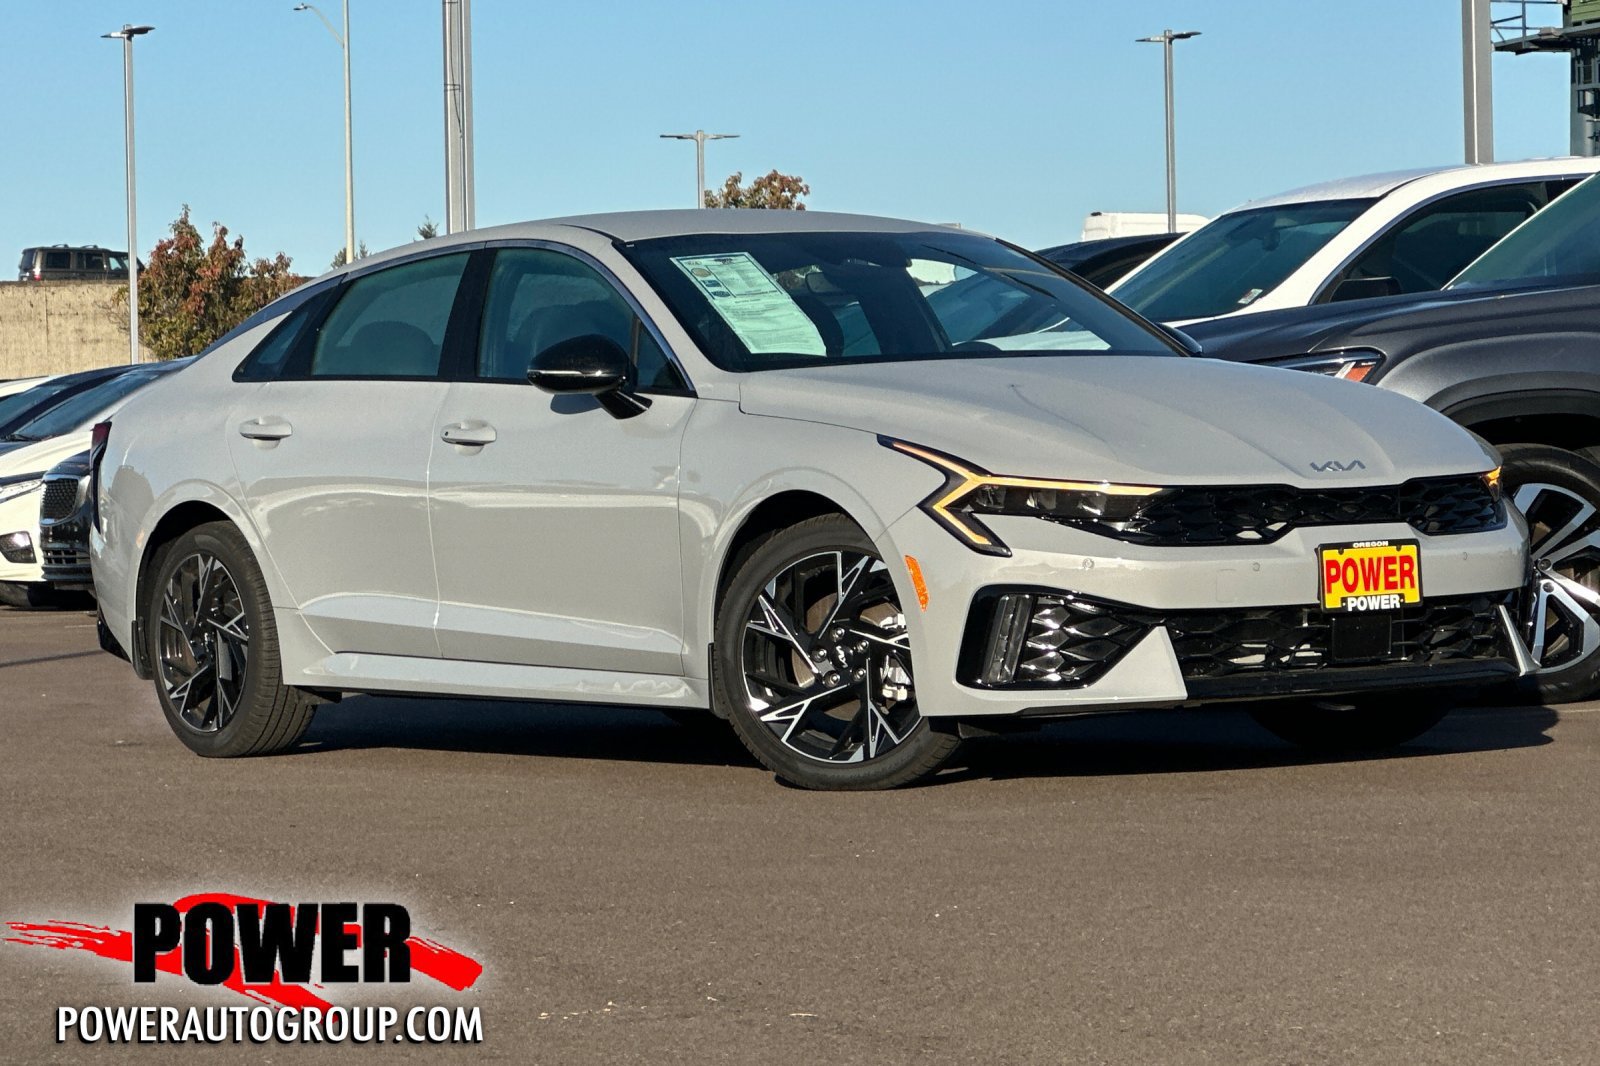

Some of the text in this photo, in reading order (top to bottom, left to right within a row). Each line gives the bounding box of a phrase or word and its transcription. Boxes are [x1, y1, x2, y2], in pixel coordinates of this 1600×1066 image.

[1352, 540, 1389, 548] OREGON
[1325, 555, 1416, 594] POWER
[1347, 594, 1401, 612] POWER
